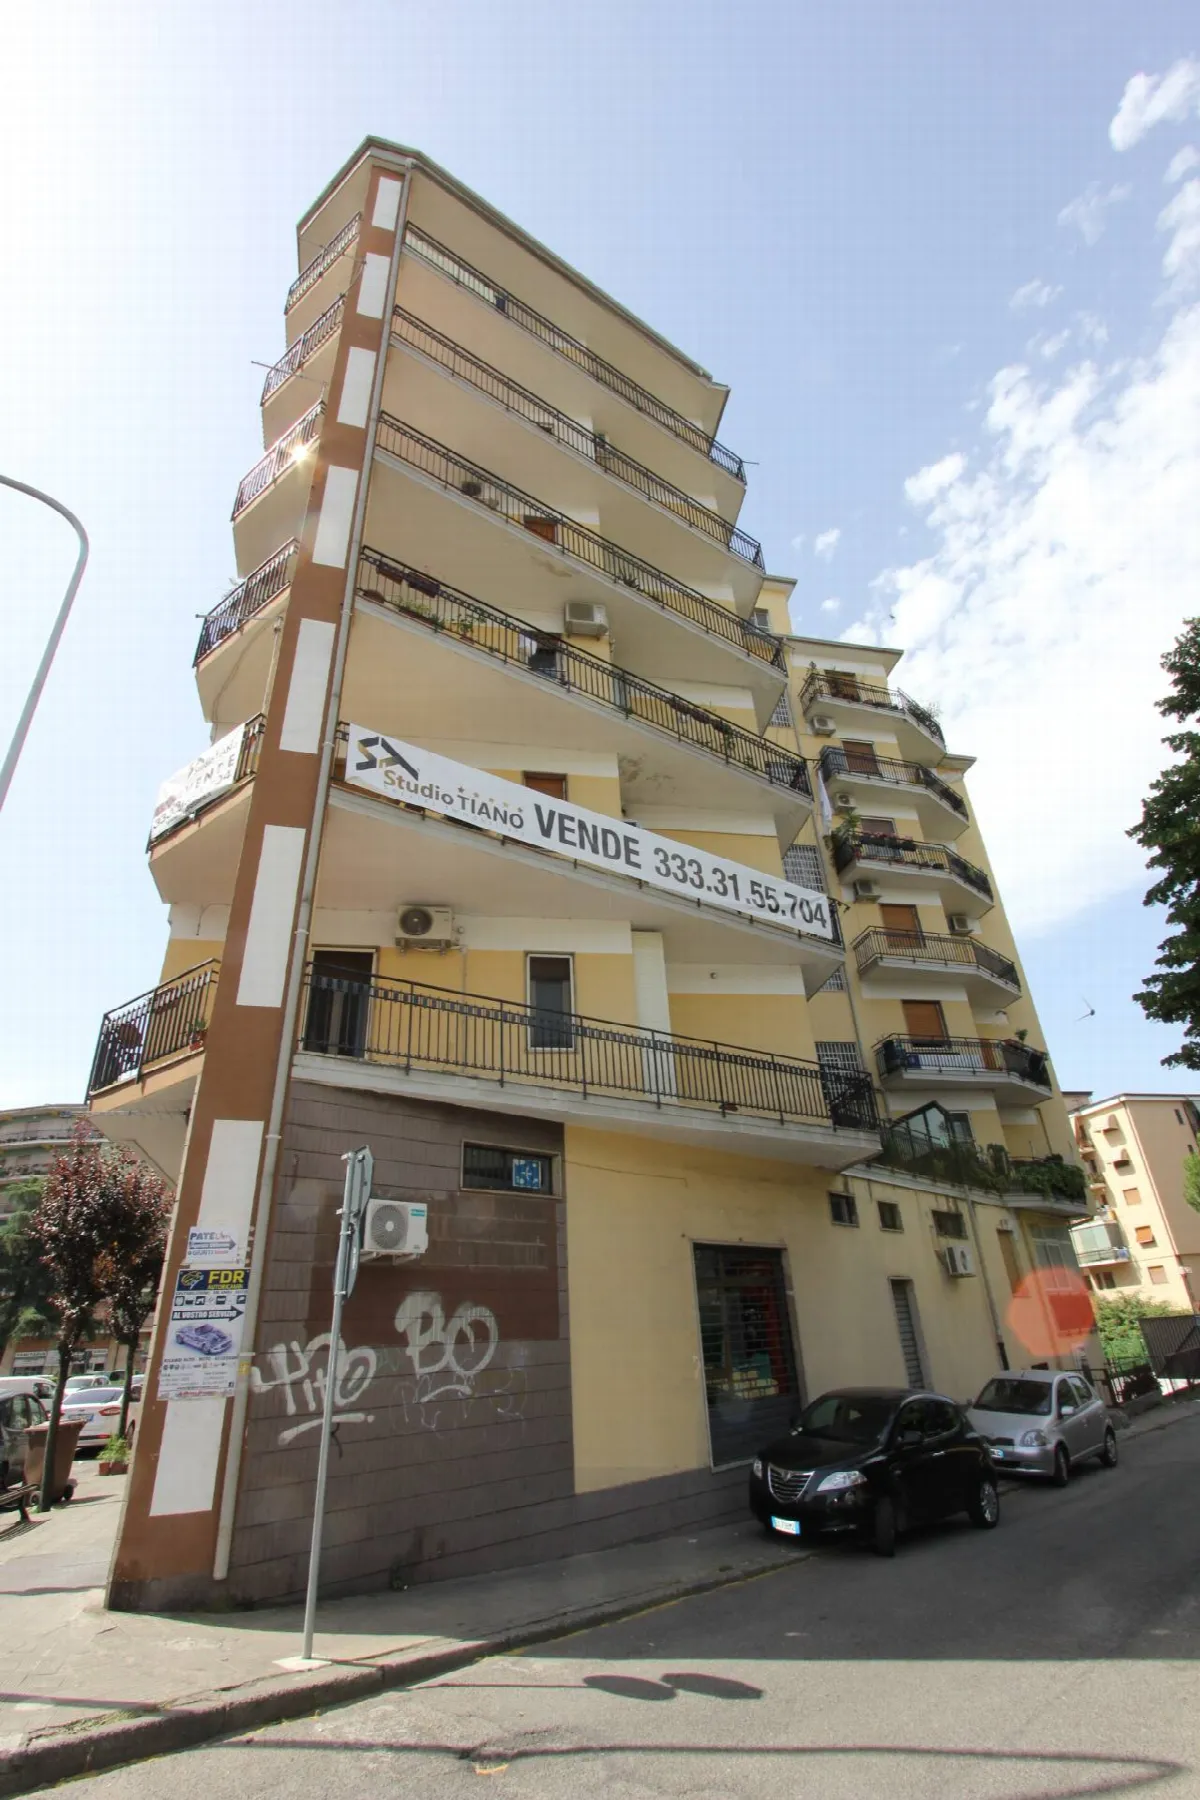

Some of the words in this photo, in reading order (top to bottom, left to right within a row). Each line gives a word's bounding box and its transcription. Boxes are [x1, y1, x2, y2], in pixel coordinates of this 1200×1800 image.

[383, 769, 454, 805] Studio
[457, 794, 524, 830] TIANO
[534, 803, 642, 870] VENDE
[653, 846, 828, 929] 333.31.55.704
[208, 1270, 245, 1284] FDR
